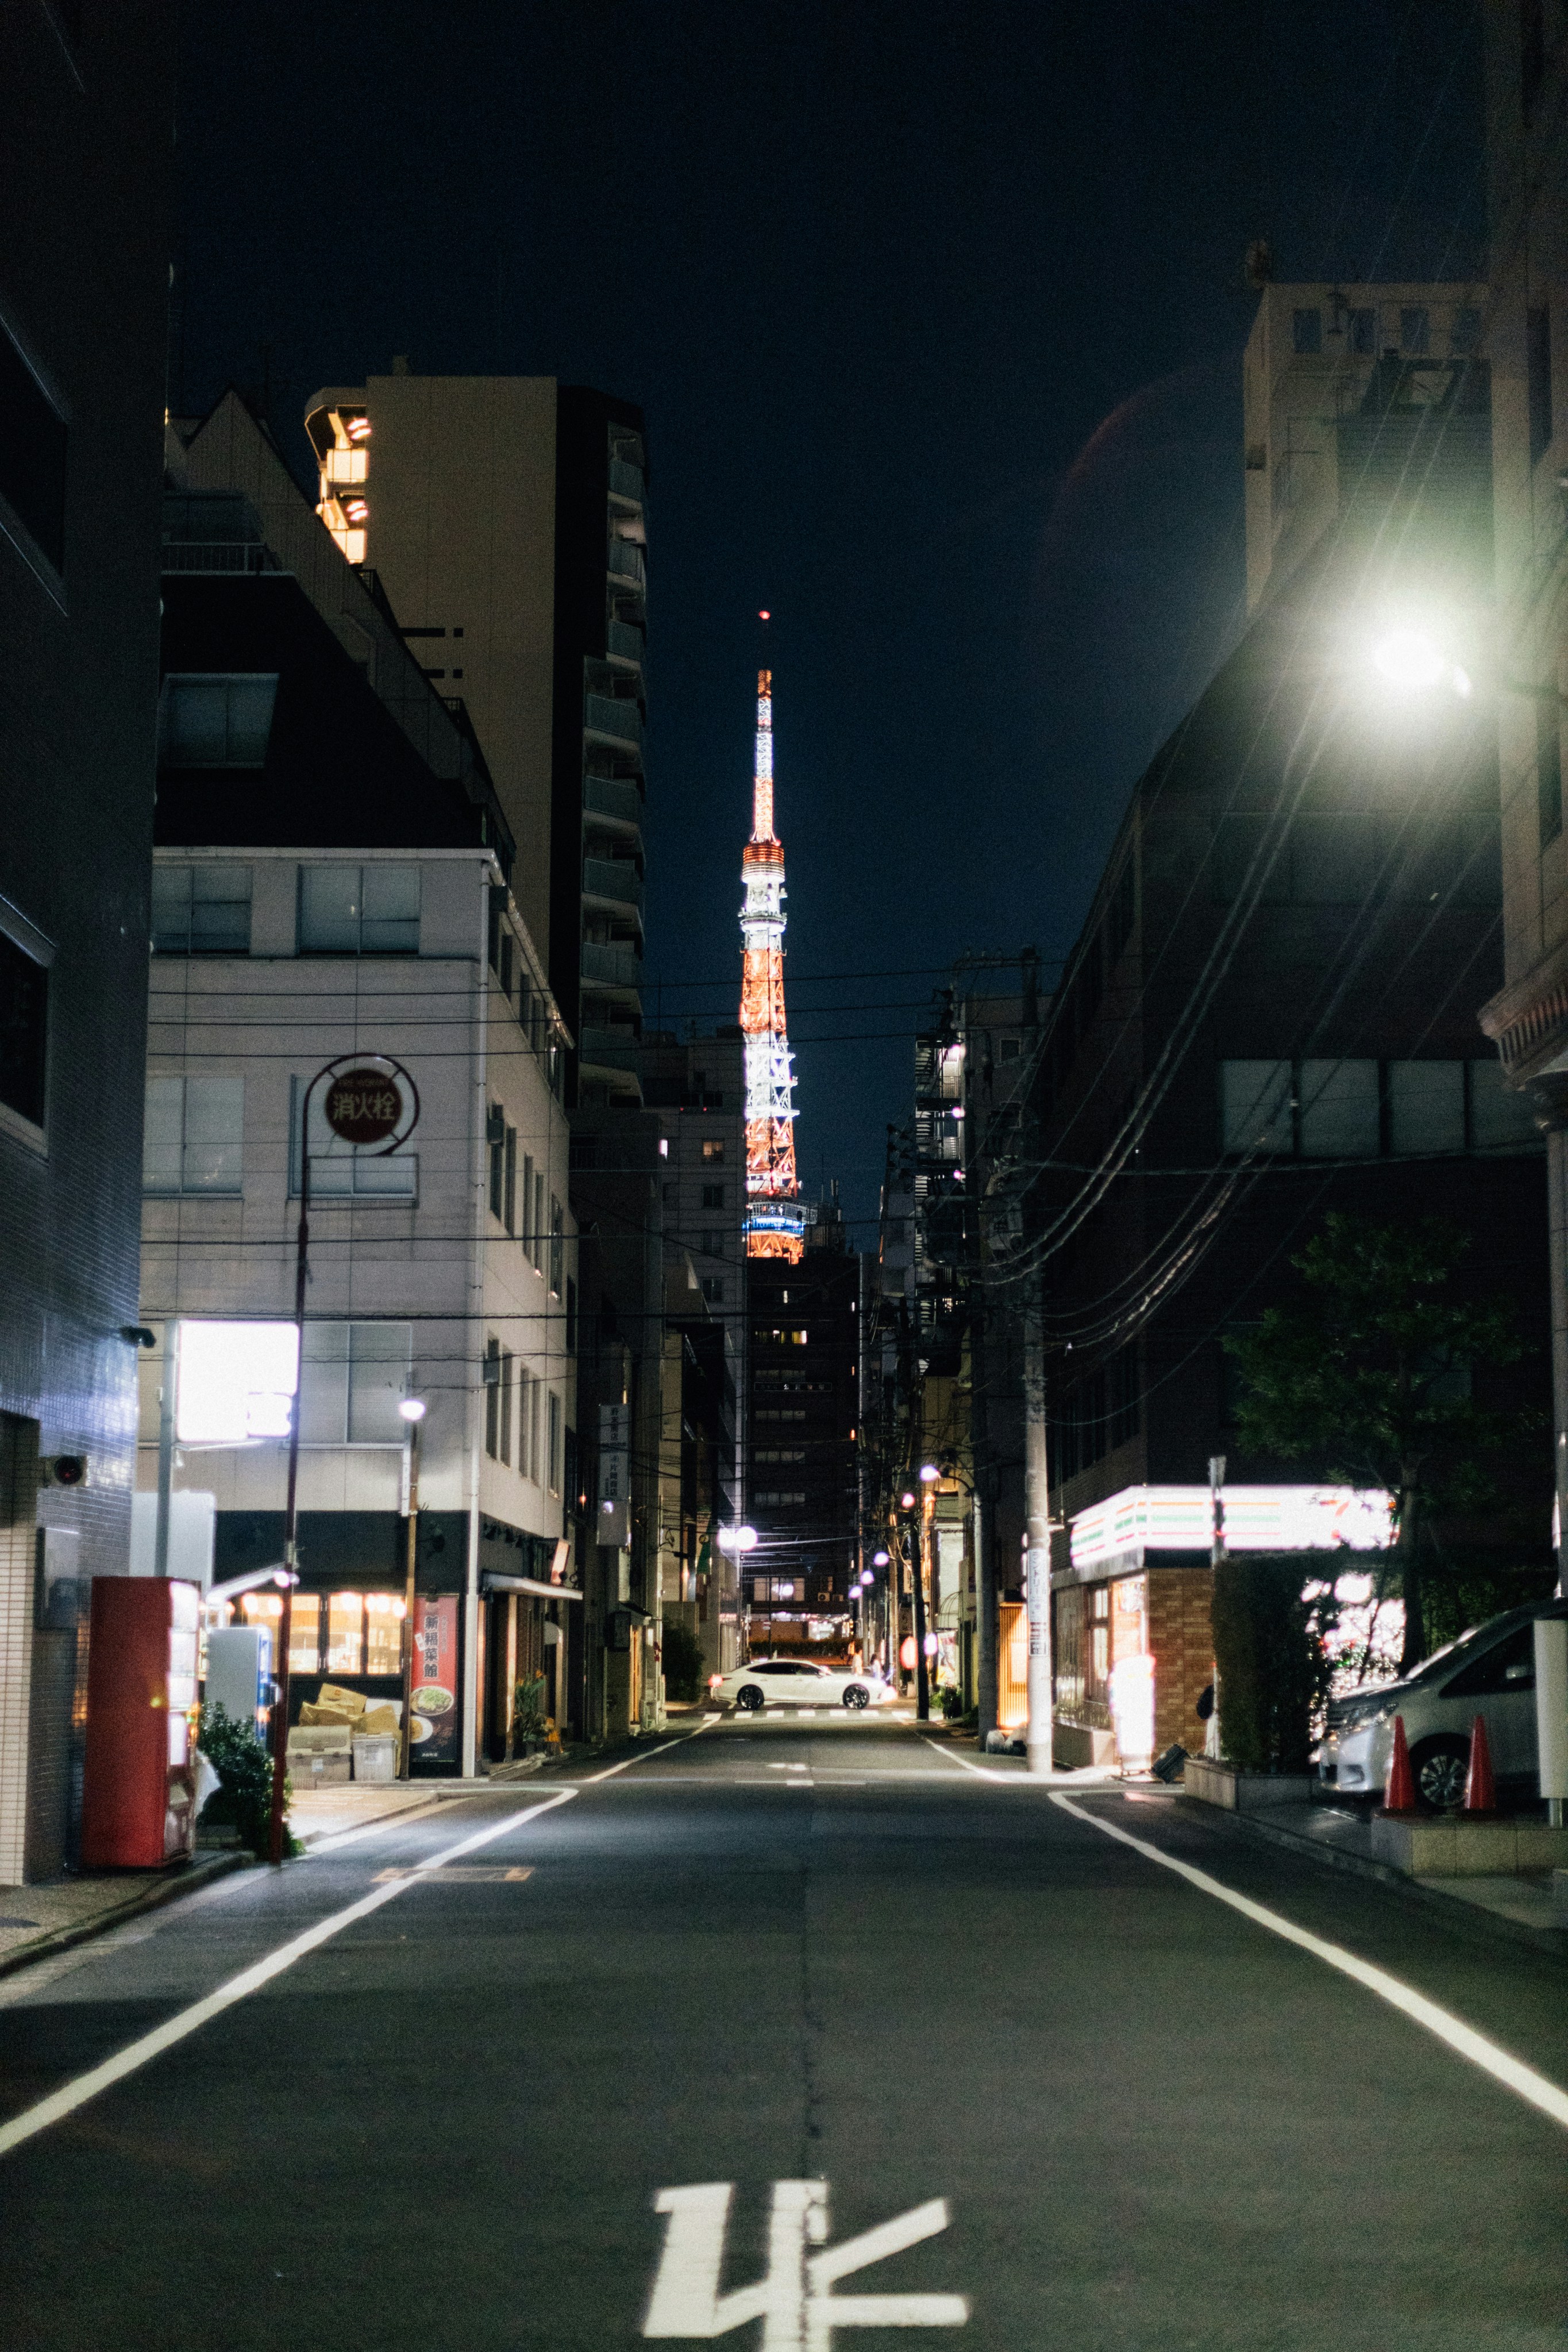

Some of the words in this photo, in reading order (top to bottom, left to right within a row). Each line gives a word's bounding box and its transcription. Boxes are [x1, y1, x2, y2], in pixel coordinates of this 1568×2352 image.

[332, 1091, 396, 1121] 消火栓
[423, 1615, 439, 1679] 新福菜館
